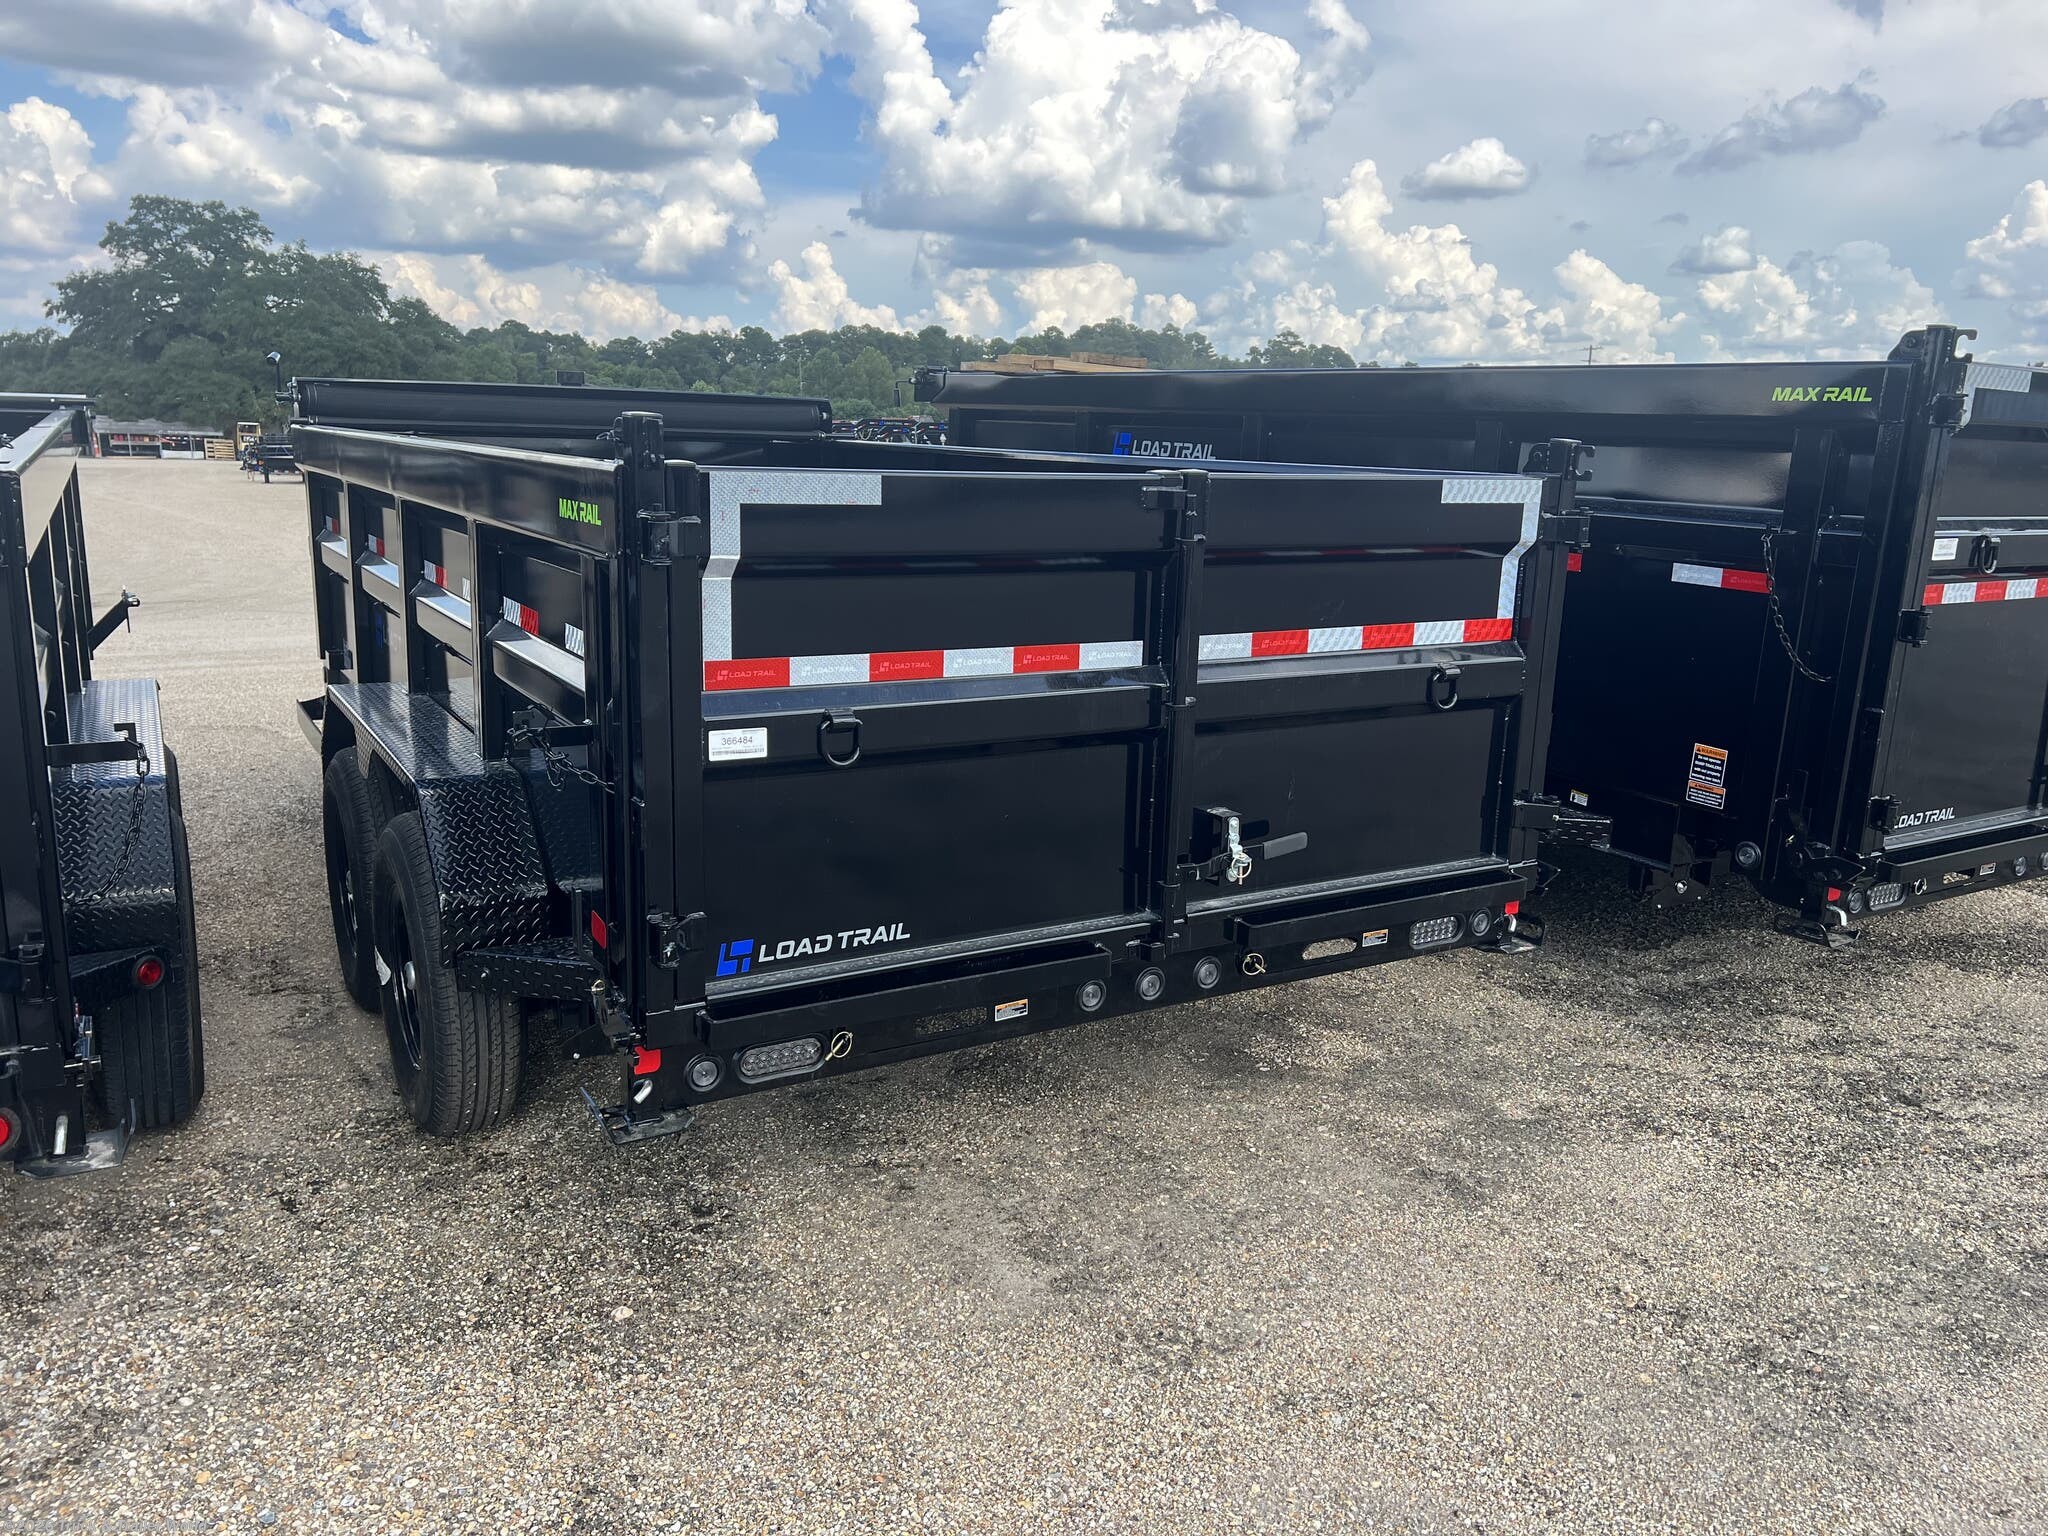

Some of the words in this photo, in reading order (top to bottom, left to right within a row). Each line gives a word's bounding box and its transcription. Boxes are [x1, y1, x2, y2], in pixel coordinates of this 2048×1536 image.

[1771, 386, 1822, 402] MAX
[1822, 386, 1873, 402] RAIL
[1132, 439, 1172, 457] LOAD
[1173, 441, 1217, 460] TRAIL
[558, 497, 579, 522] MAX
[579, 501, 602, 527] RAIL
[728, 671, 752, 679] LOAD
[753, 669, 777, 677] TRAIL
[889, 662, 910, 671] LOAD
[911, 660, 932, 669] TRAIL
[721, 736, 752, 746] 366484
[1893, 812, 1924, 829] OAD
[1924, 806, 1956, 824] TRAIL
[757, 933, 834, 964] LOAD
[836, 922, 911, 950] TRAIL
